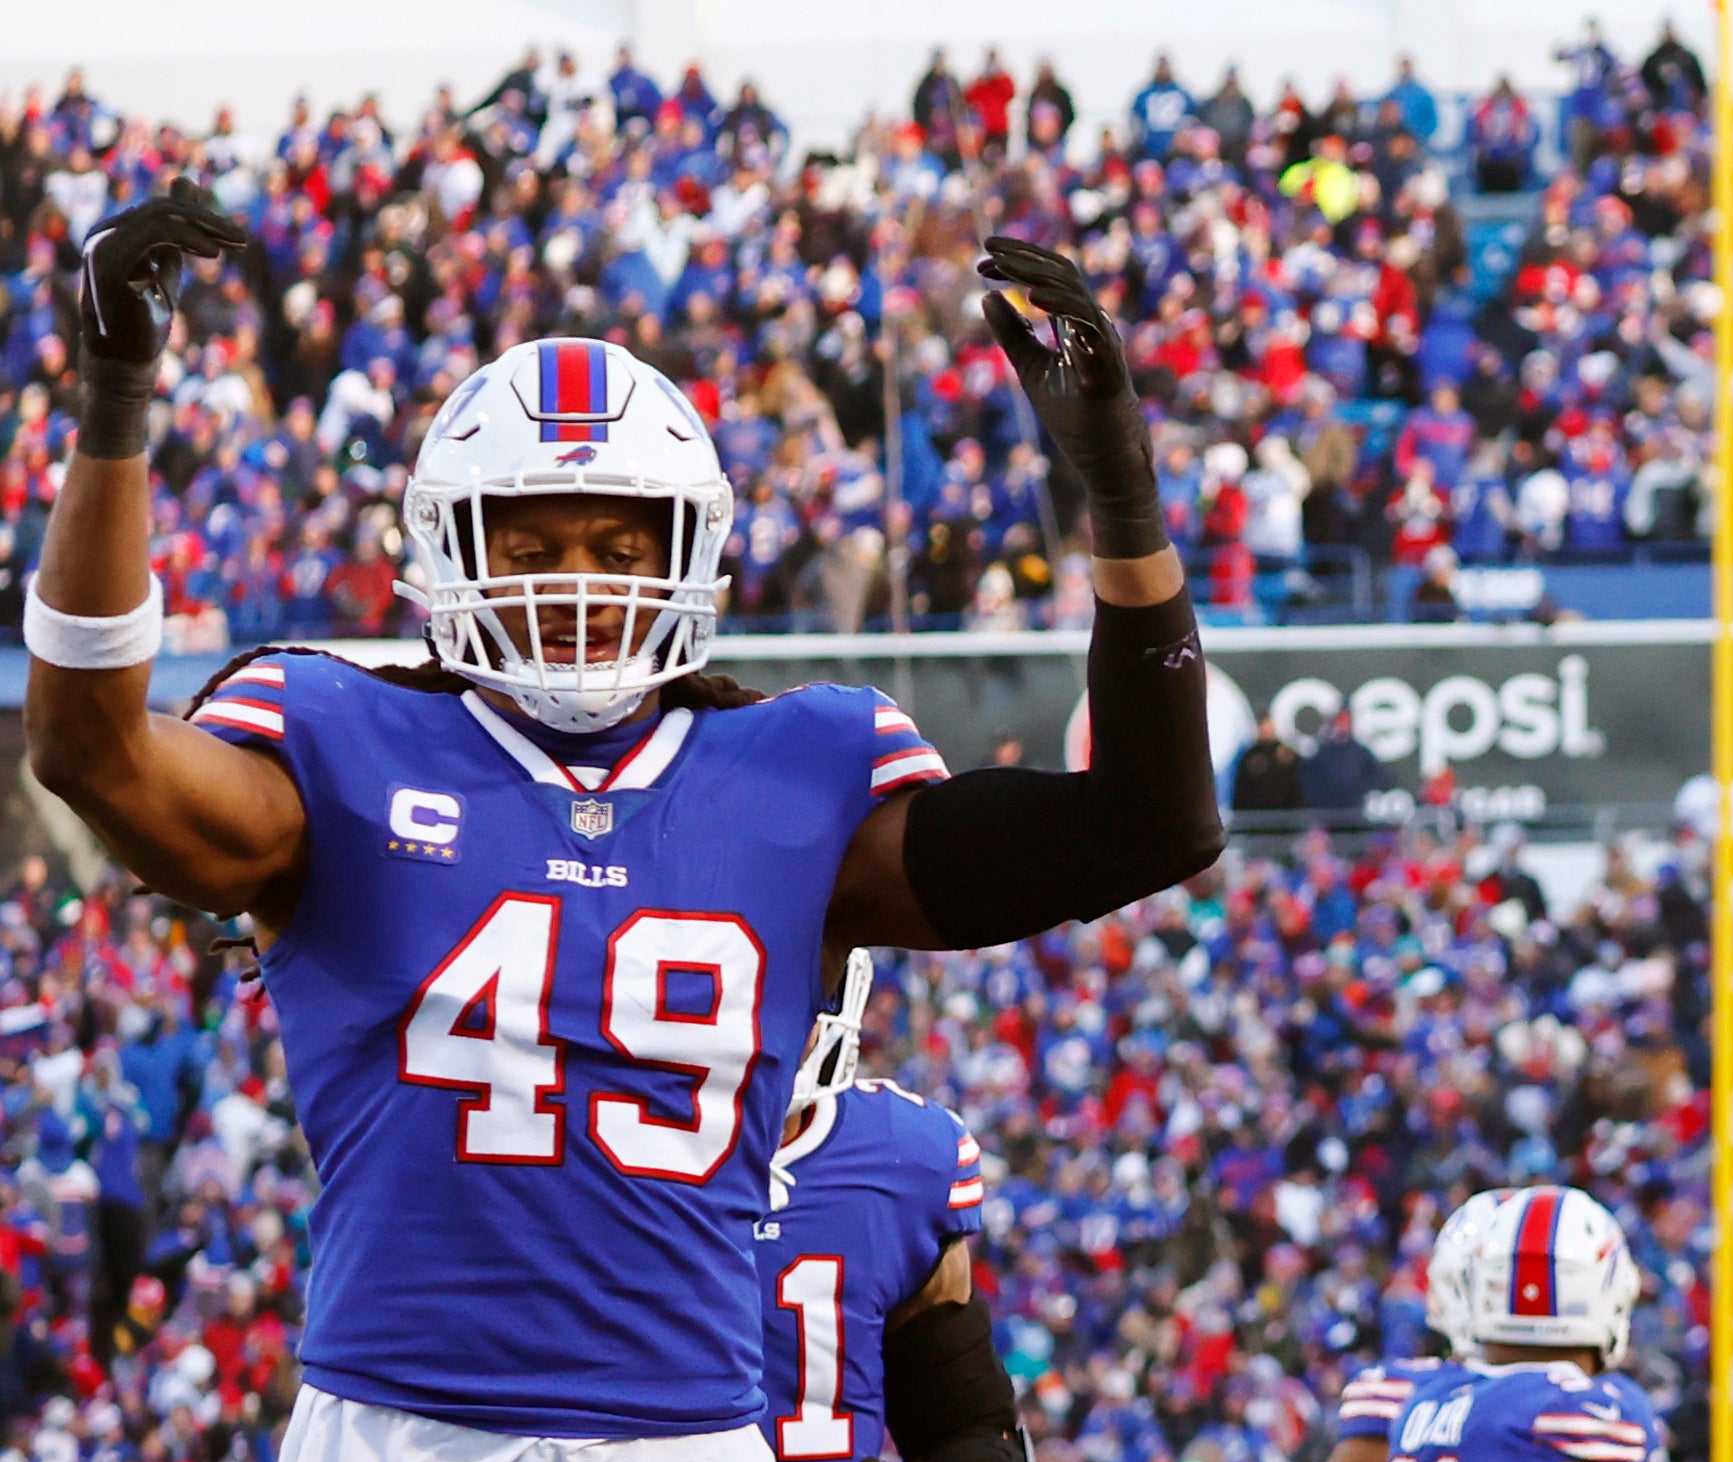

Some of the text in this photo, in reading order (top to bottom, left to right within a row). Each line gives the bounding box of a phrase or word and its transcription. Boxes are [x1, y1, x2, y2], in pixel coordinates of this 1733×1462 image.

[388, 787, 461, 845] C
[545, 858, 629, 888] BILLS
[398, 888, 767, 1186] 49
[776, 1252, 854, 1462] 1
